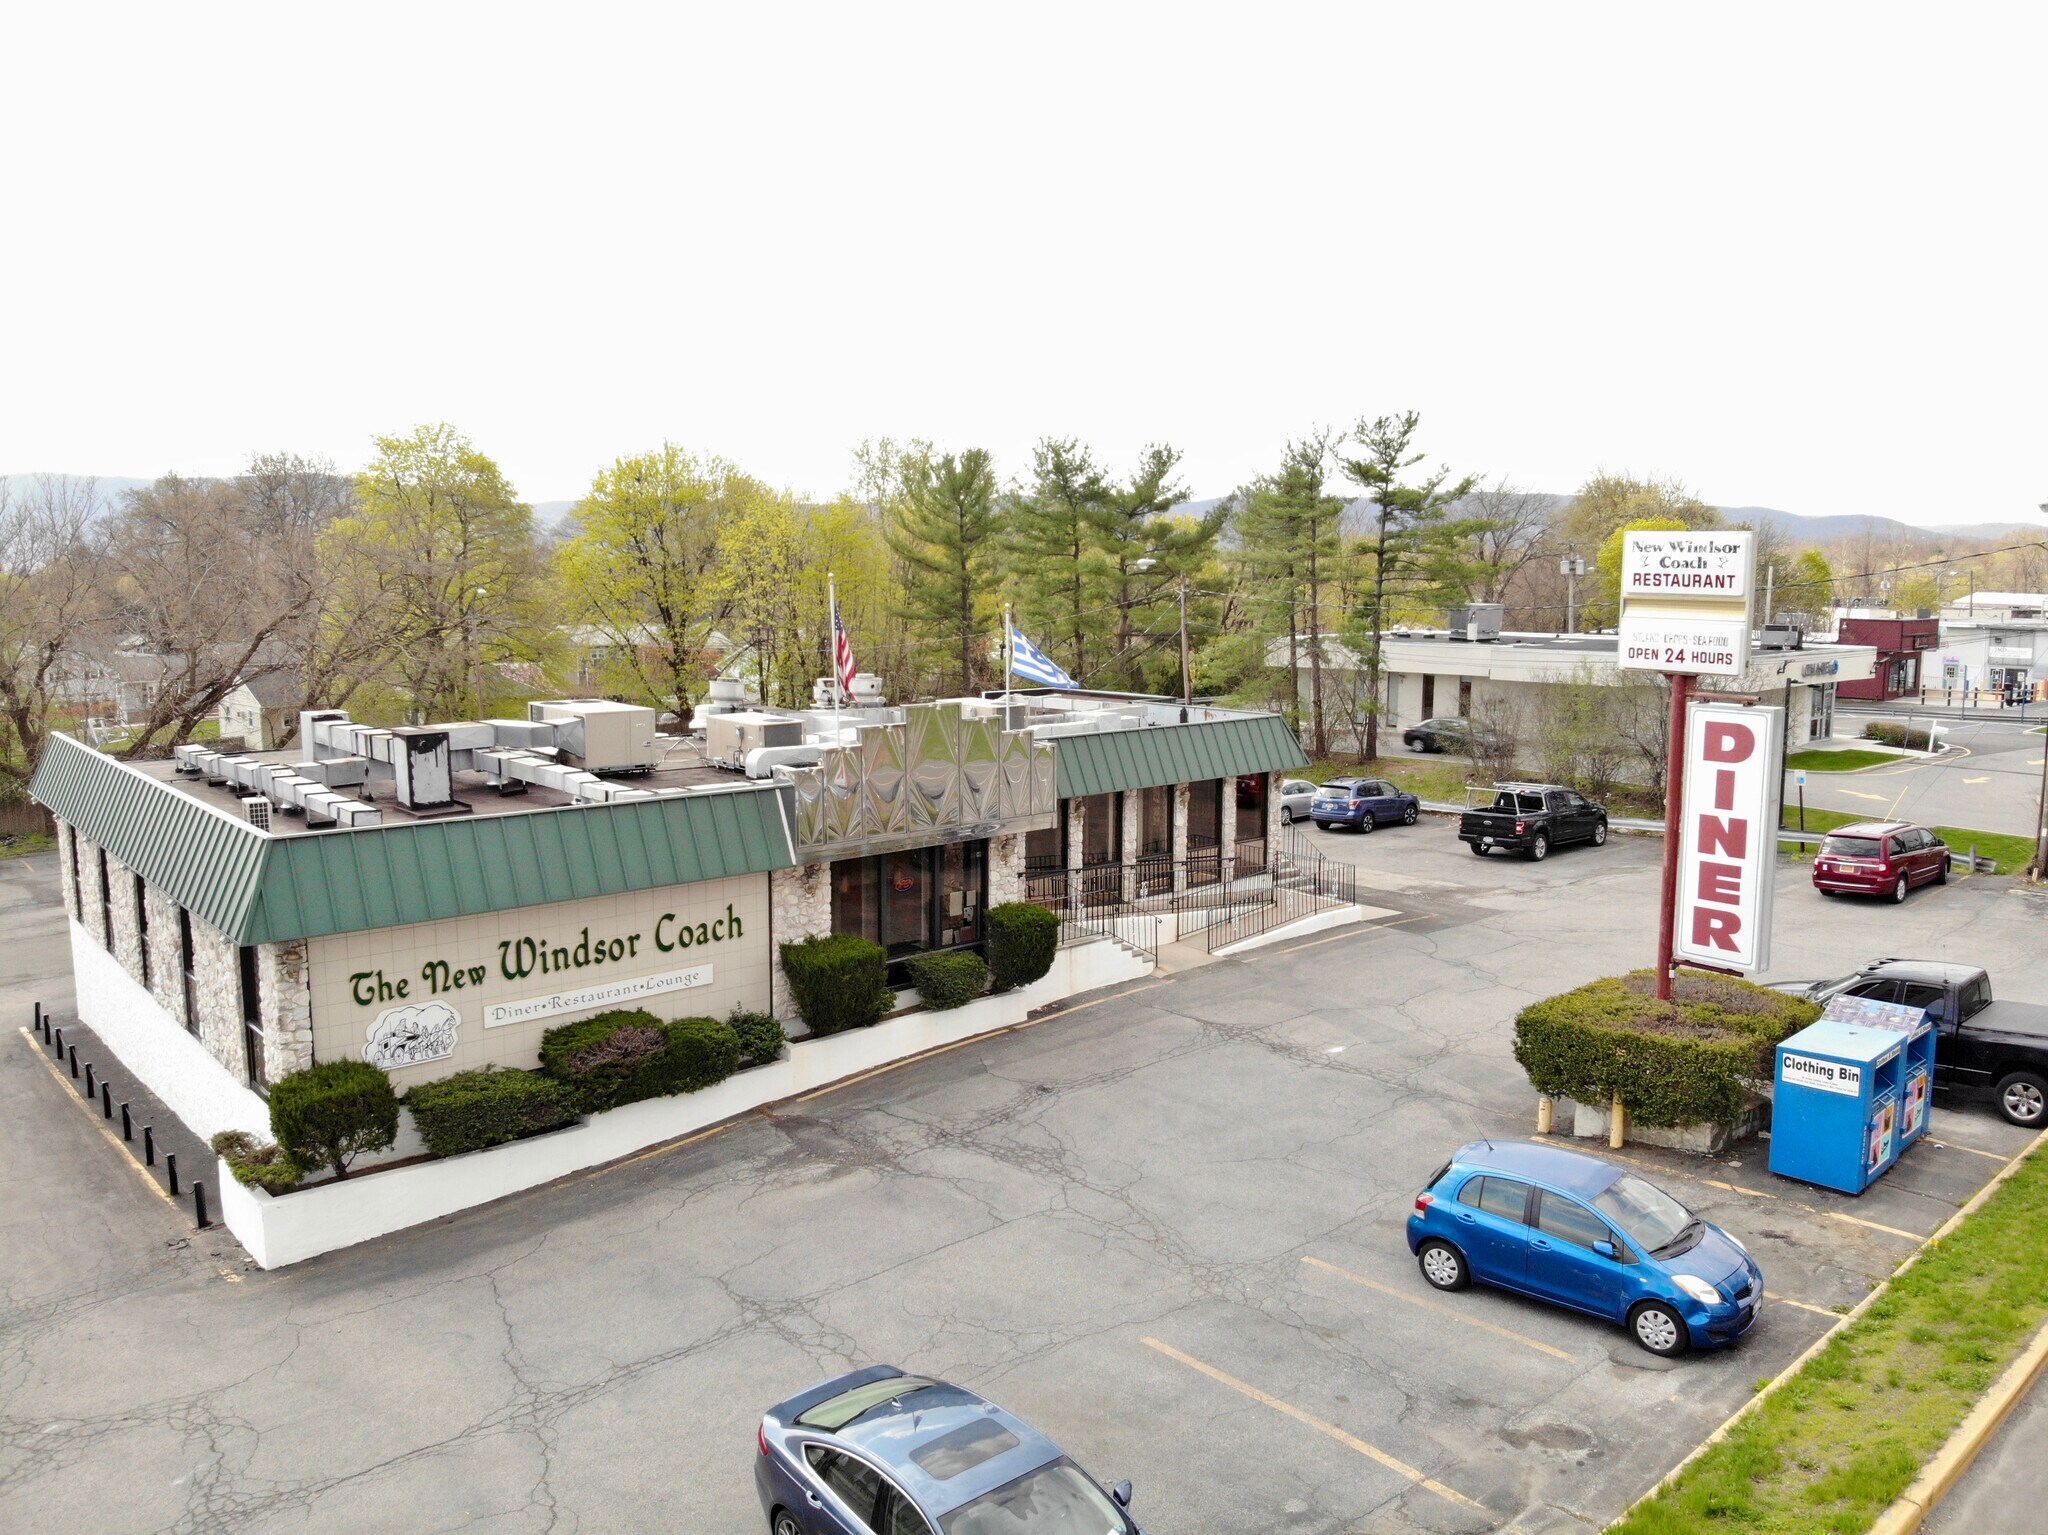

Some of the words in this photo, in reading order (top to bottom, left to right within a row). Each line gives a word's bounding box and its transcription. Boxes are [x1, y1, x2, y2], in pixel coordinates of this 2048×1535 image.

[1632, 540, 1664, 553] New
[1669, 540, 1741, 554] Windsor
[1660, 556, 1708, 569] Coach
[1633, 573, 1736, 589] RESTAURANT
[1628, 647, 1659, 660] OPEN
[1665, 648, 1686, 664] 24
[1691, 651, 1733, 665] HOURS
[1692, 720, 1756, 953] DINER
[349, 969, 410, 1006] The
[422, 960, 486, 995] New
[498, 926, 642, 981] Windsor
[654, 903, 744, 954] Coach
[1783, 1056, 1834, 1080] Clothing
[1839, 1067, 1859, 1082] Bin
